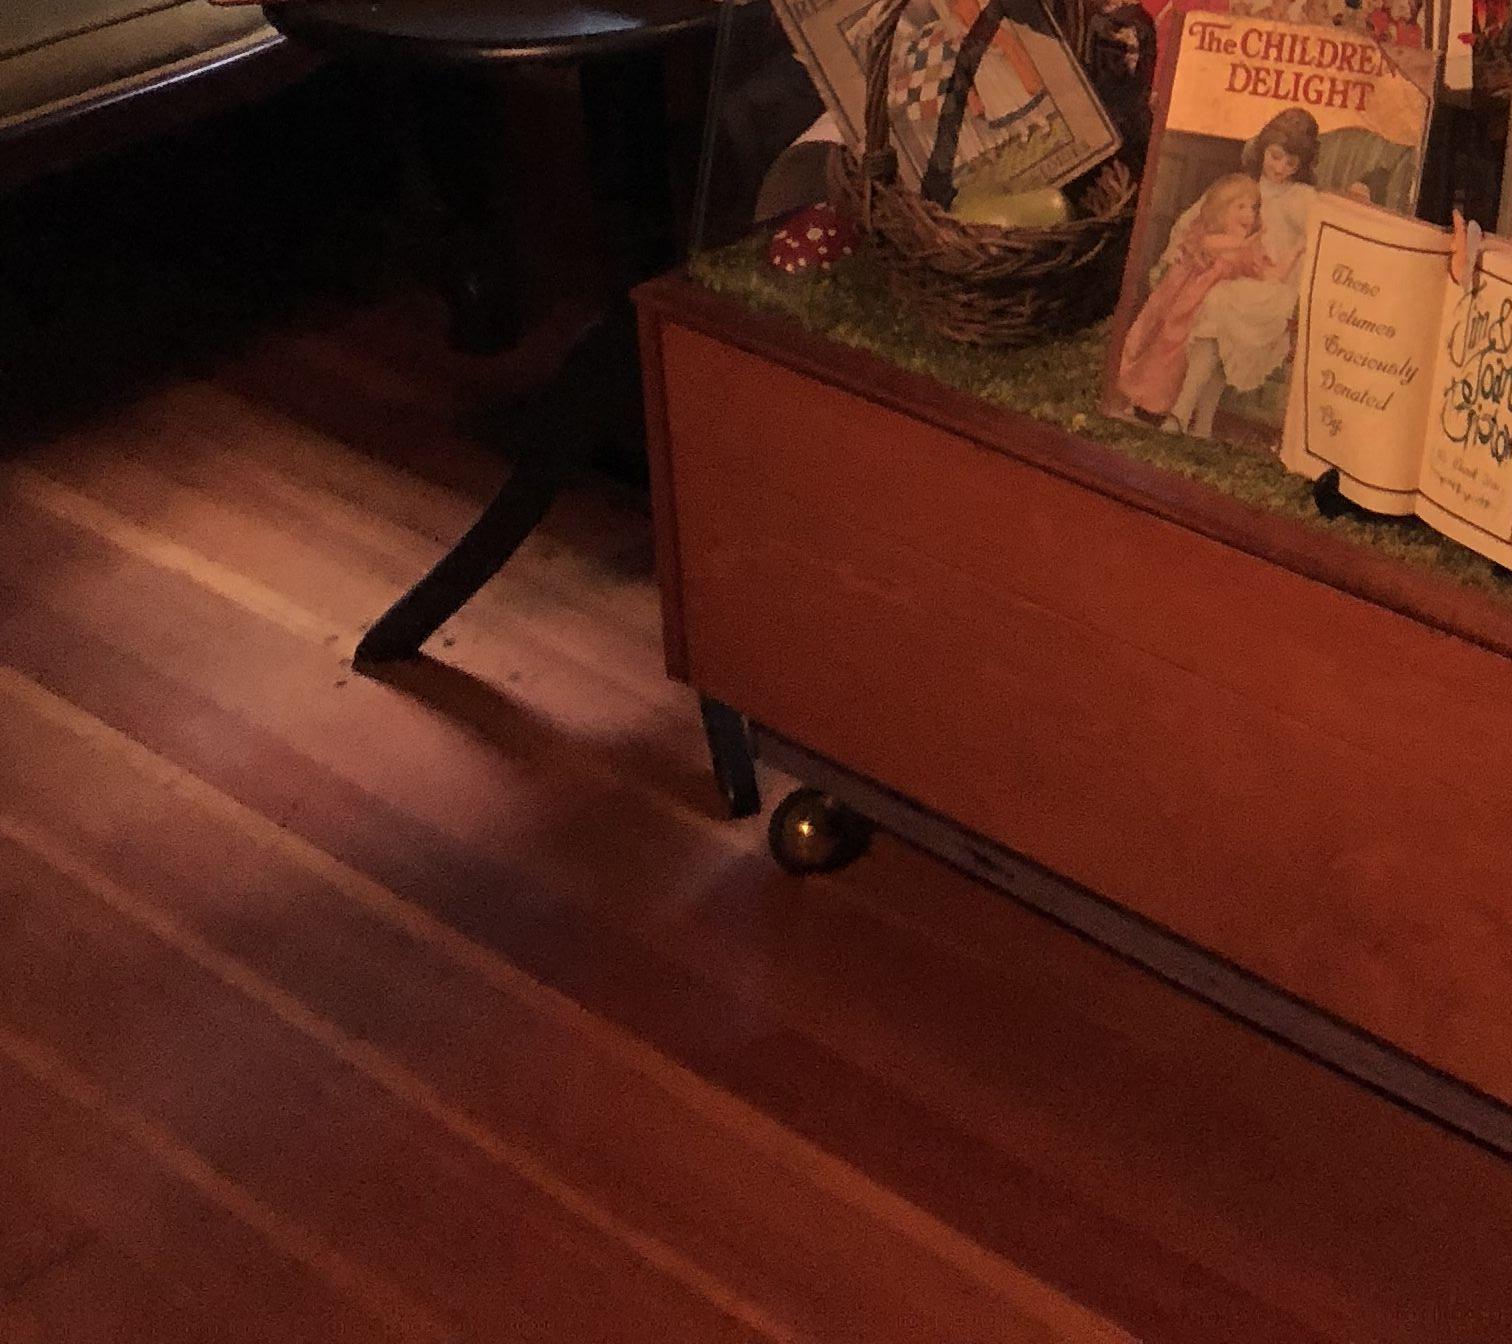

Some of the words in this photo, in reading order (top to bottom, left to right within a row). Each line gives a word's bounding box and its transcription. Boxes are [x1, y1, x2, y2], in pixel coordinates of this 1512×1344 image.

[1188, 20, 1238, 56] The
[1224, 62, 1376, 112] DELIGHT
[1331, 262, 1381, 298] These
[1323, 333, 1420, 387] Graciously
[1320, 368, 1396, 413] Donated
[1318, 403, 1344, 438] By
